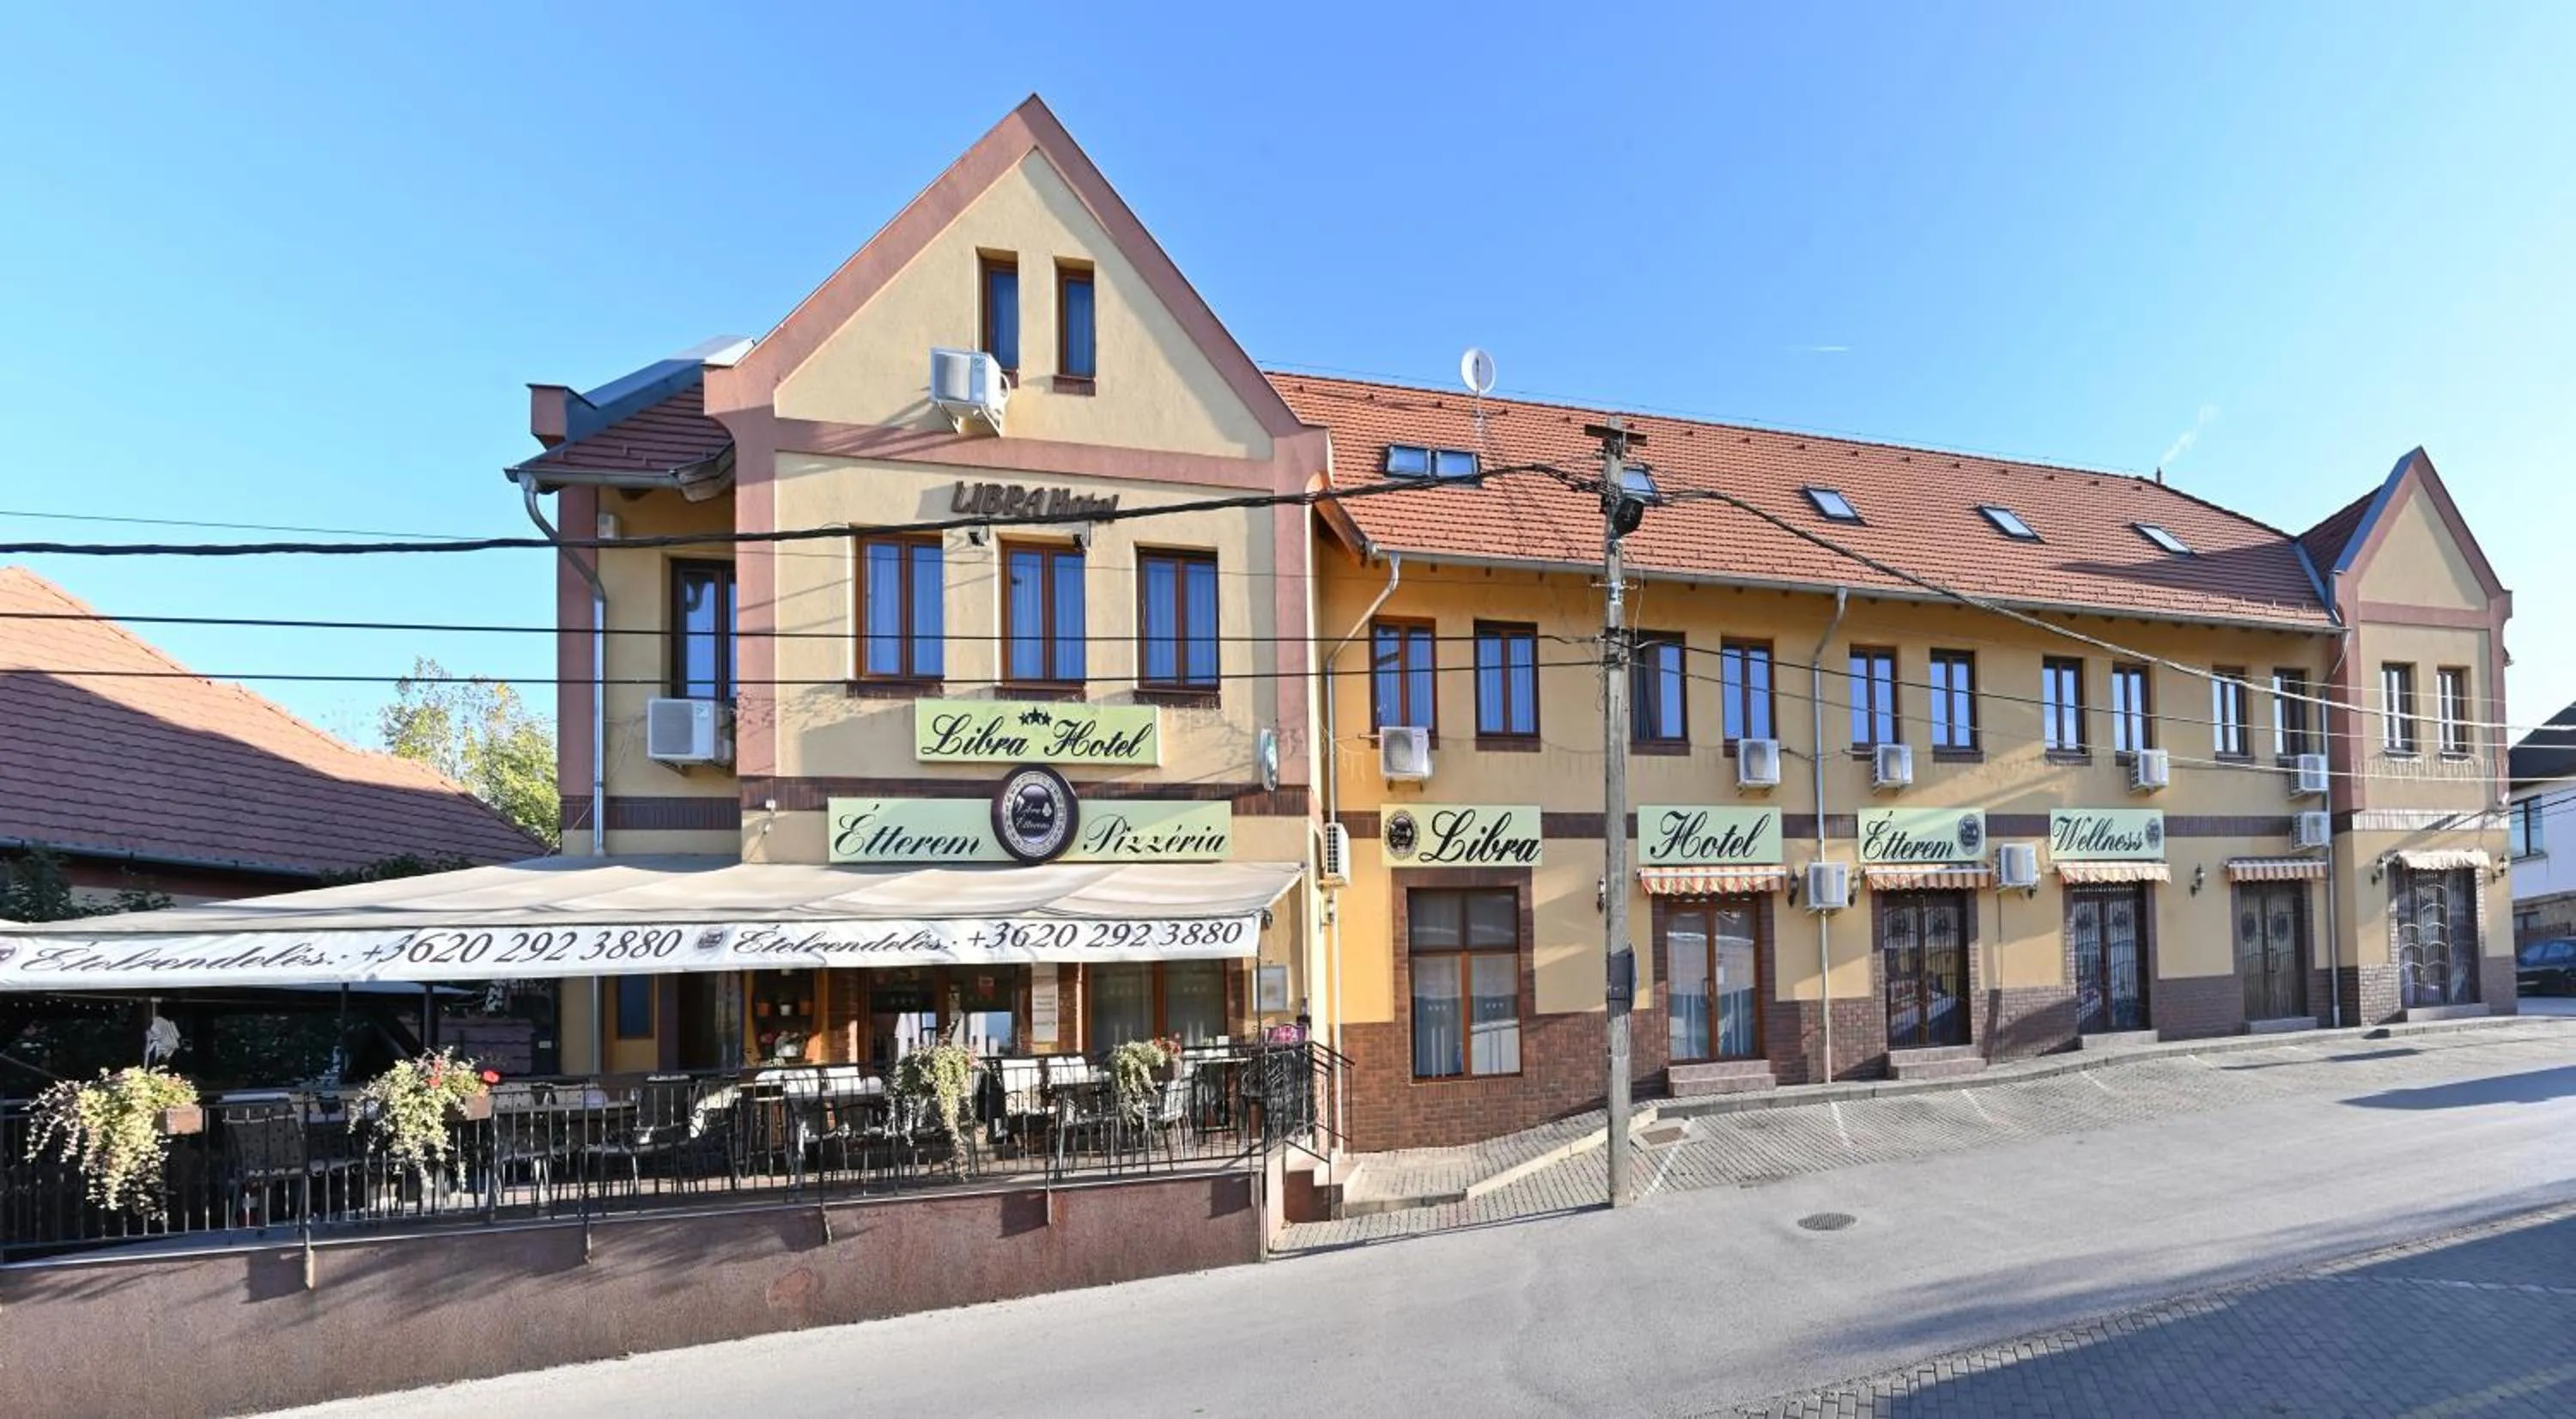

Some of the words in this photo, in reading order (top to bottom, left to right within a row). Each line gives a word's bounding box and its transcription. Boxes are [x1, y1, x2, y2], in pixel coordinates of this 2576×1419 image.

[951, 481, 1045, 516] LIBRA
[920, 714, 1030, 757] Libra
[1043, 719, 1154, 758] Hotel
[834, 803, 985, 856] Étterem
[1083, 813, 1228, 855] Pizzéria
[1419, 807, 1542, 862] Libra
[1649, 810, 1772, 860] Hotel
[1862, 810, 1957, 860] Étterem
[2051, 813, 2144, 852] Wellness
[361, 932, 494, 965] +3620
[494, 931, 578, 964] 292
[578, 929, 683, 960] 3880
[966, 921, 1078, 949] +3620
[1084, 922, 1153, 948] 292
[1157, 921, 1243, 947] 3880
